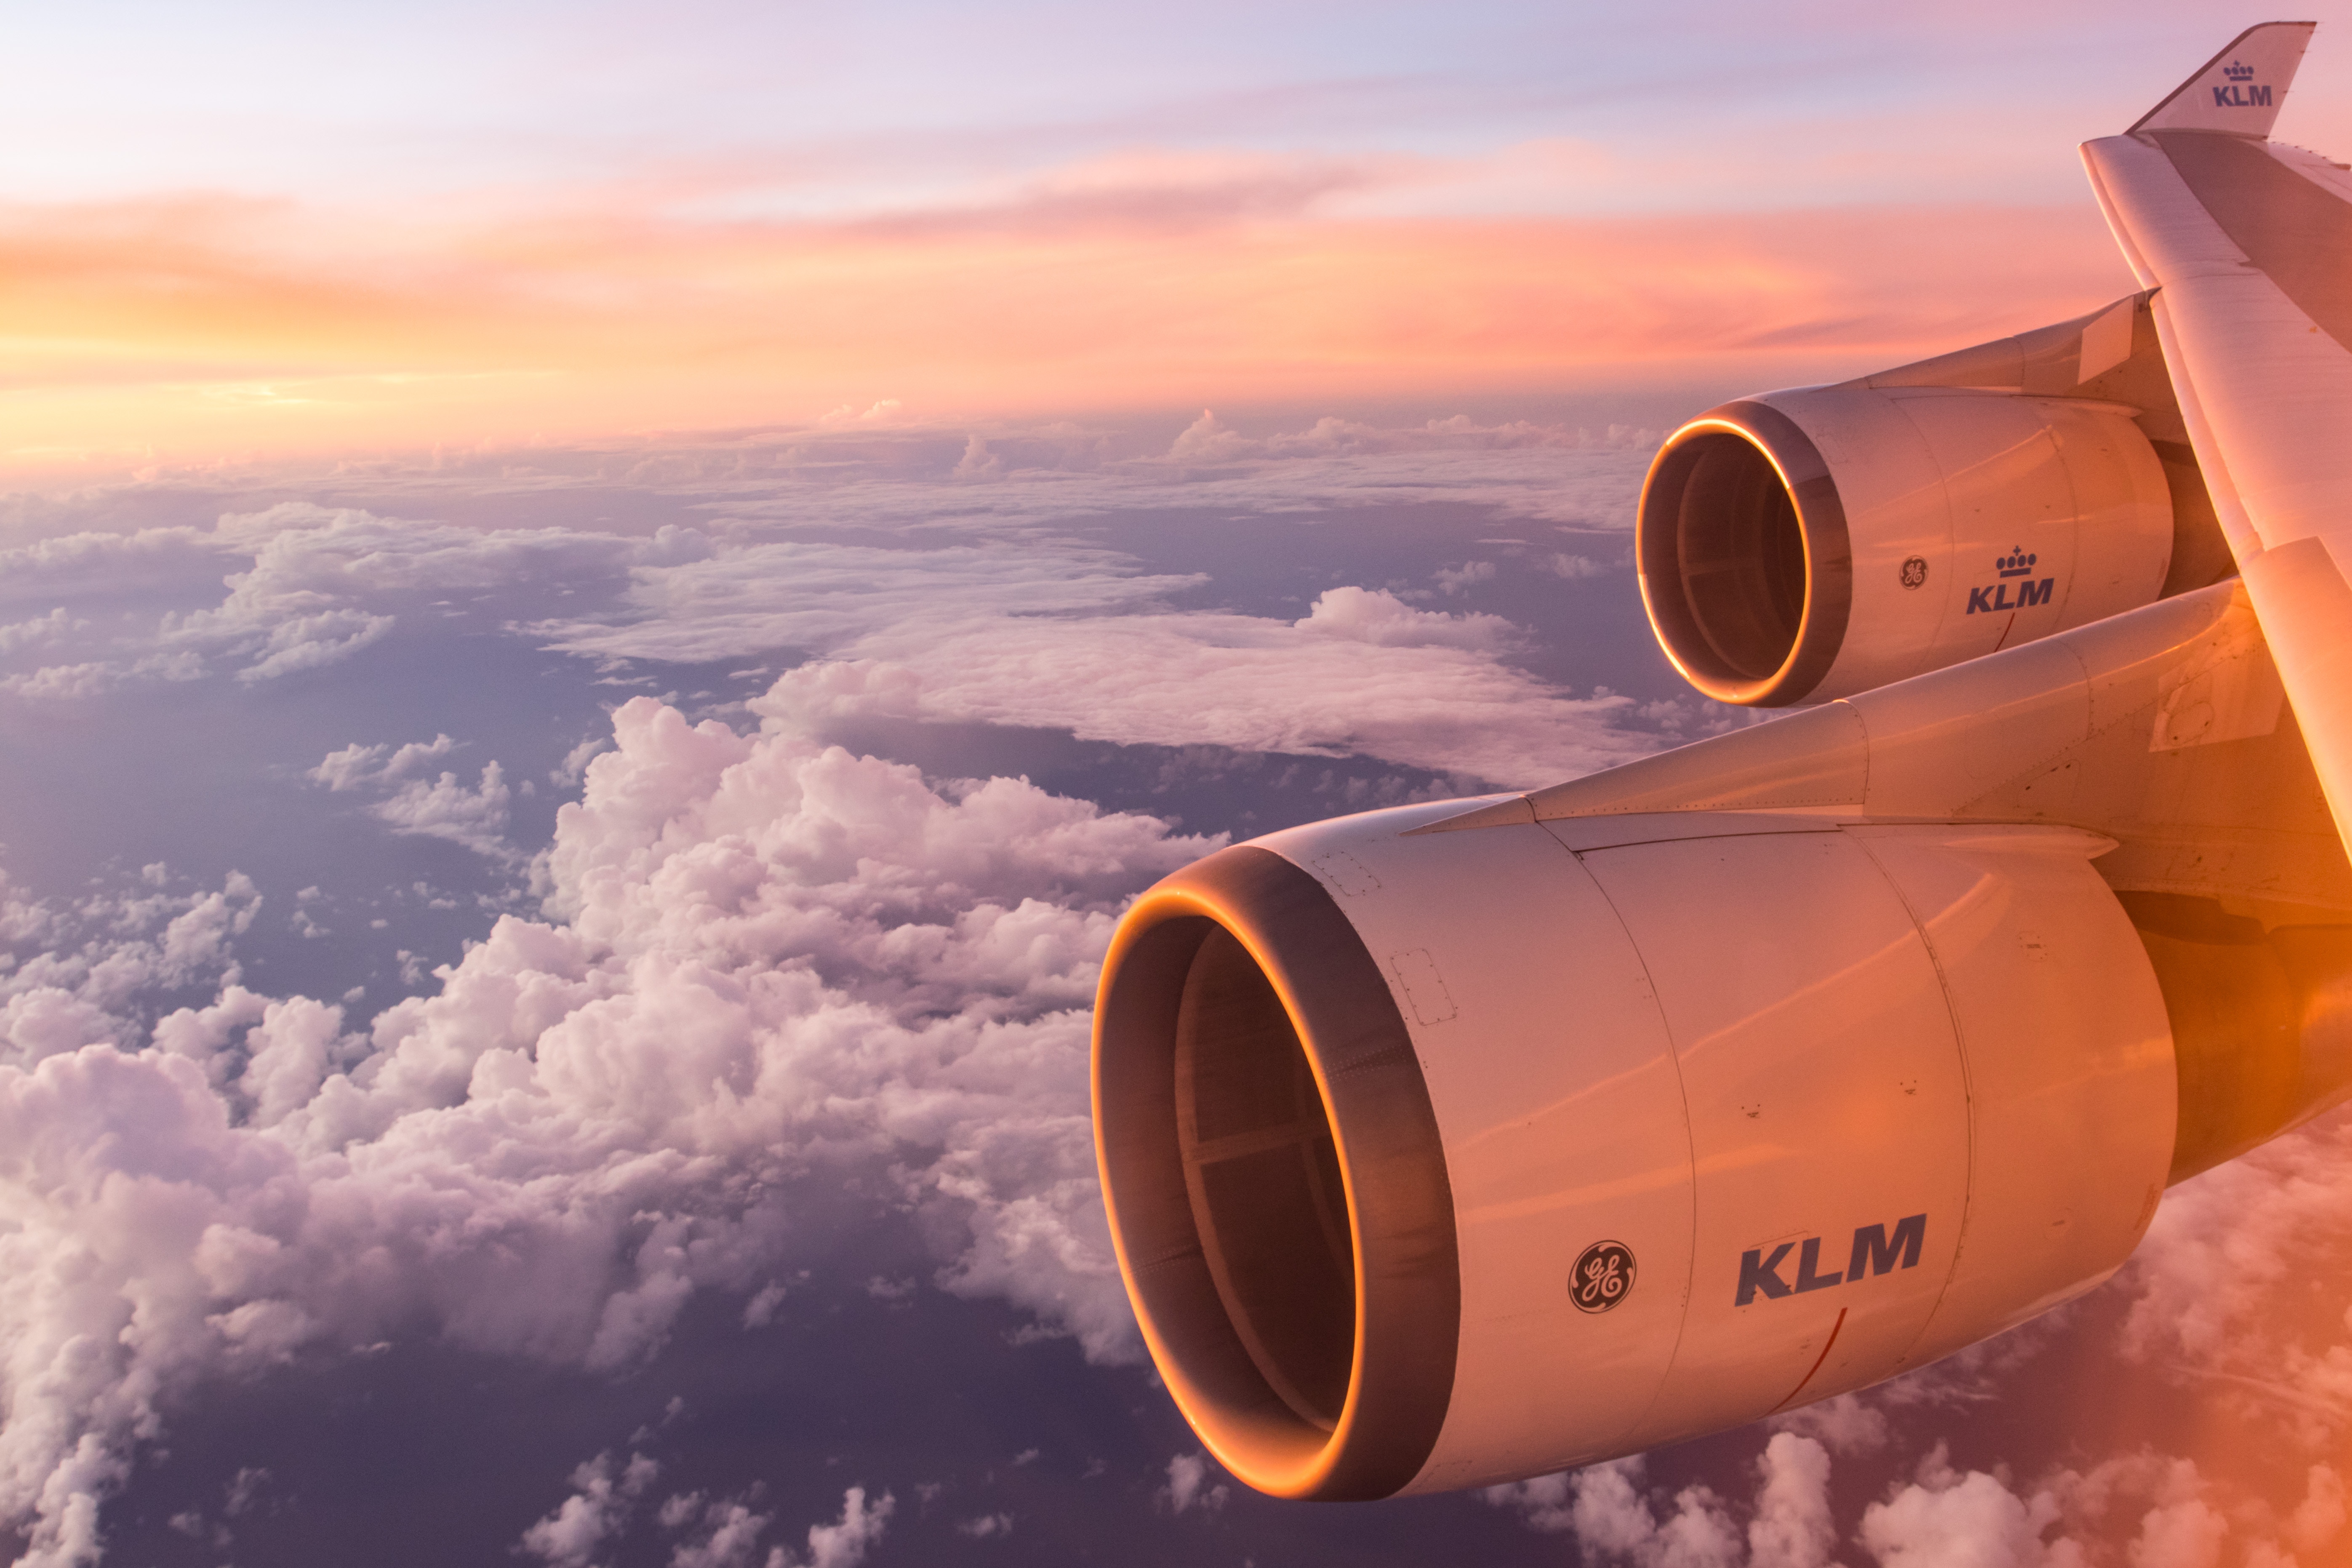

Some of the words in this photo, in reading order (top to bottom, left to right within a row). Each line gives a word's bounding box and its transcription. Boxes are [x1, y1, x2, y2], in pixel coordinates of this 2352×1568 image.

[2213, 85, 2272, 107] KLM
[1966, 577, 2055, 615] KLM
[1734, 1213, 1927, 1307] KLM
